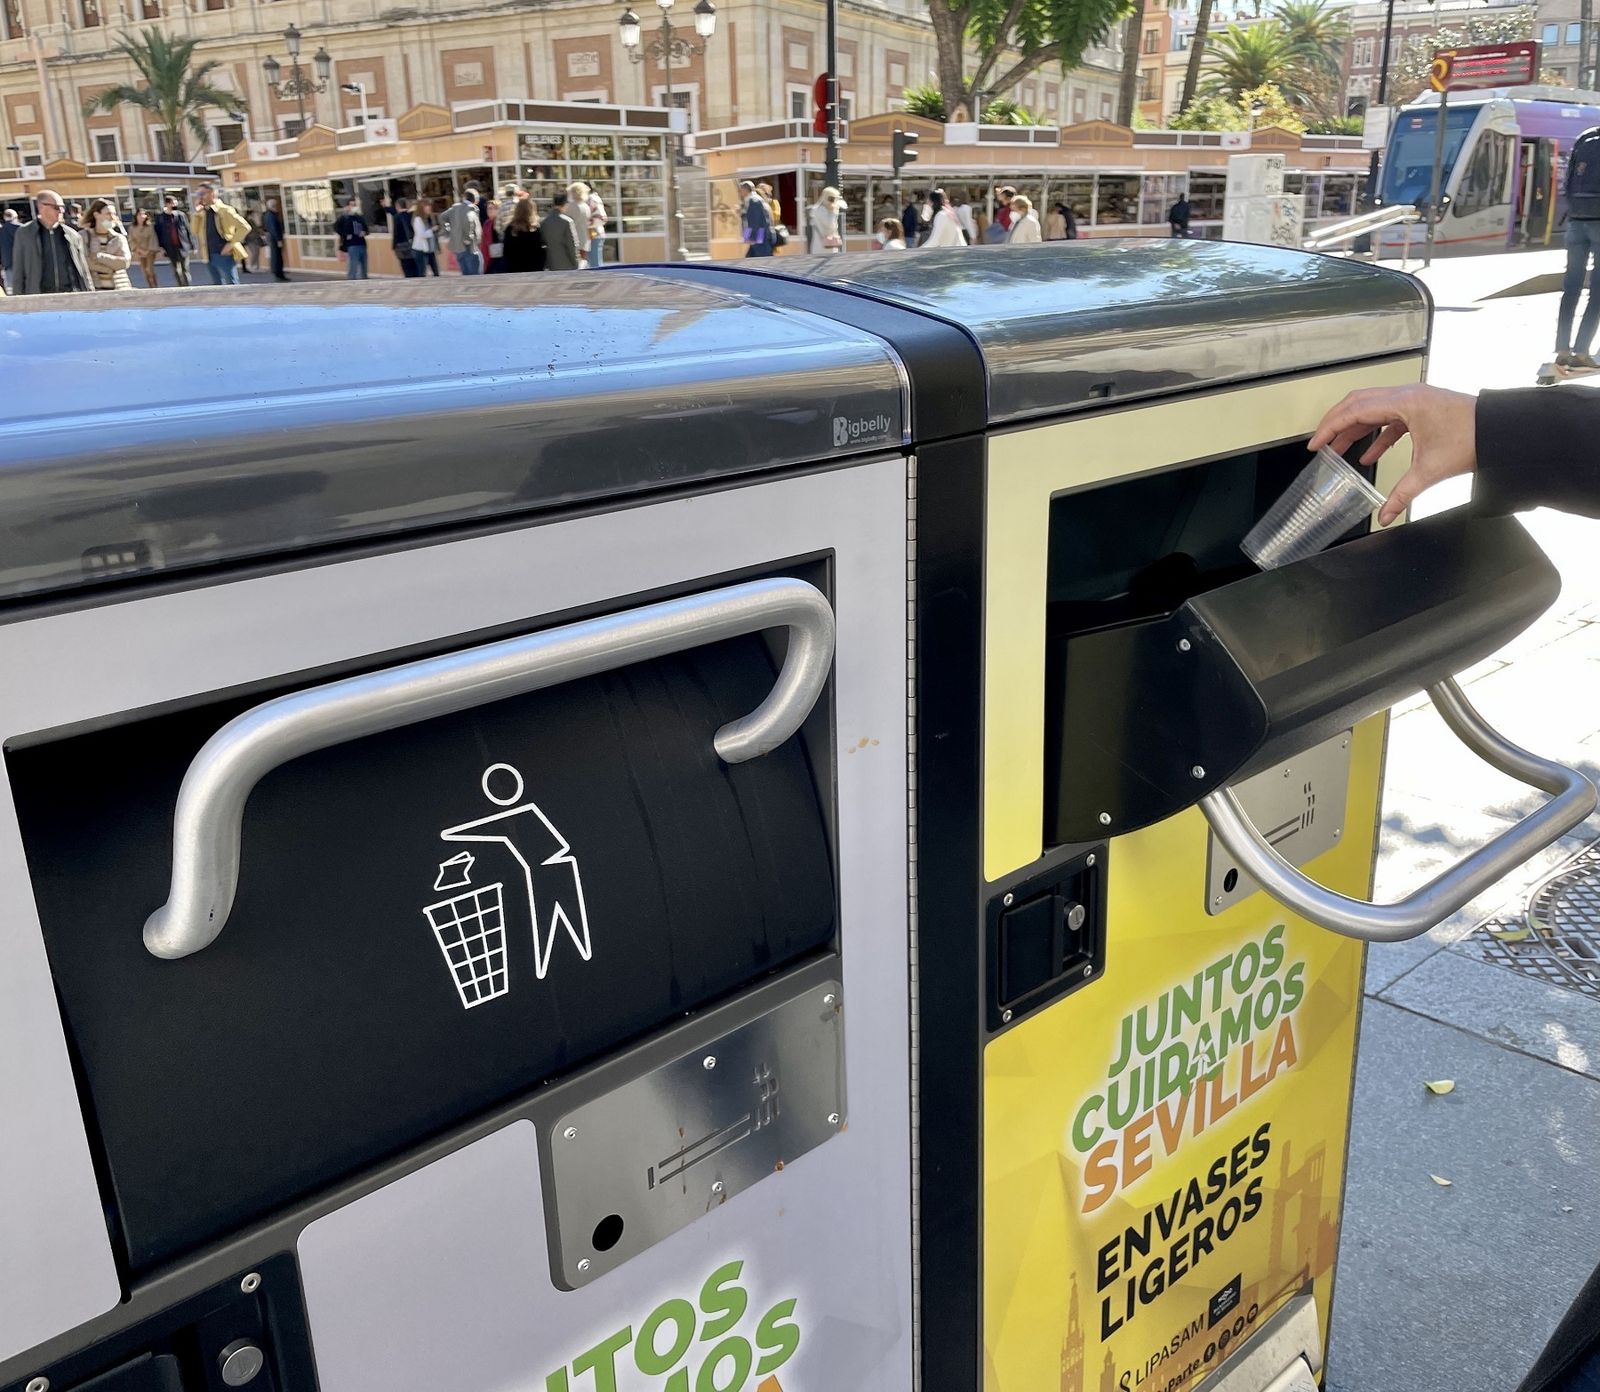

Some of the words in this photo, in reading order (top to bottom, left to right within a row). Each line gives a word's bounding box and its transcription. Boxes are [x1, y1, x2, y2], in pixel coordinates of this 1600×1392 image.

[833, 414, 891, 447] Bigbelly
[1072, 962, 1305, 1152] CUIDAMOS
[1108, 924, 1285, 1078] JUNTOS
[1081, 1015, 1297, 1214] SEVILLA
[1097, 1122, 1271, 1293] ENVASES
[1101, 1176, 1263, 1343] LIGEROS
[545, 1260, 748, 1392] TOS
[664, 1298, 800, 1392] OS
[1135, 1312, 1204, 1386] LIPASAM
